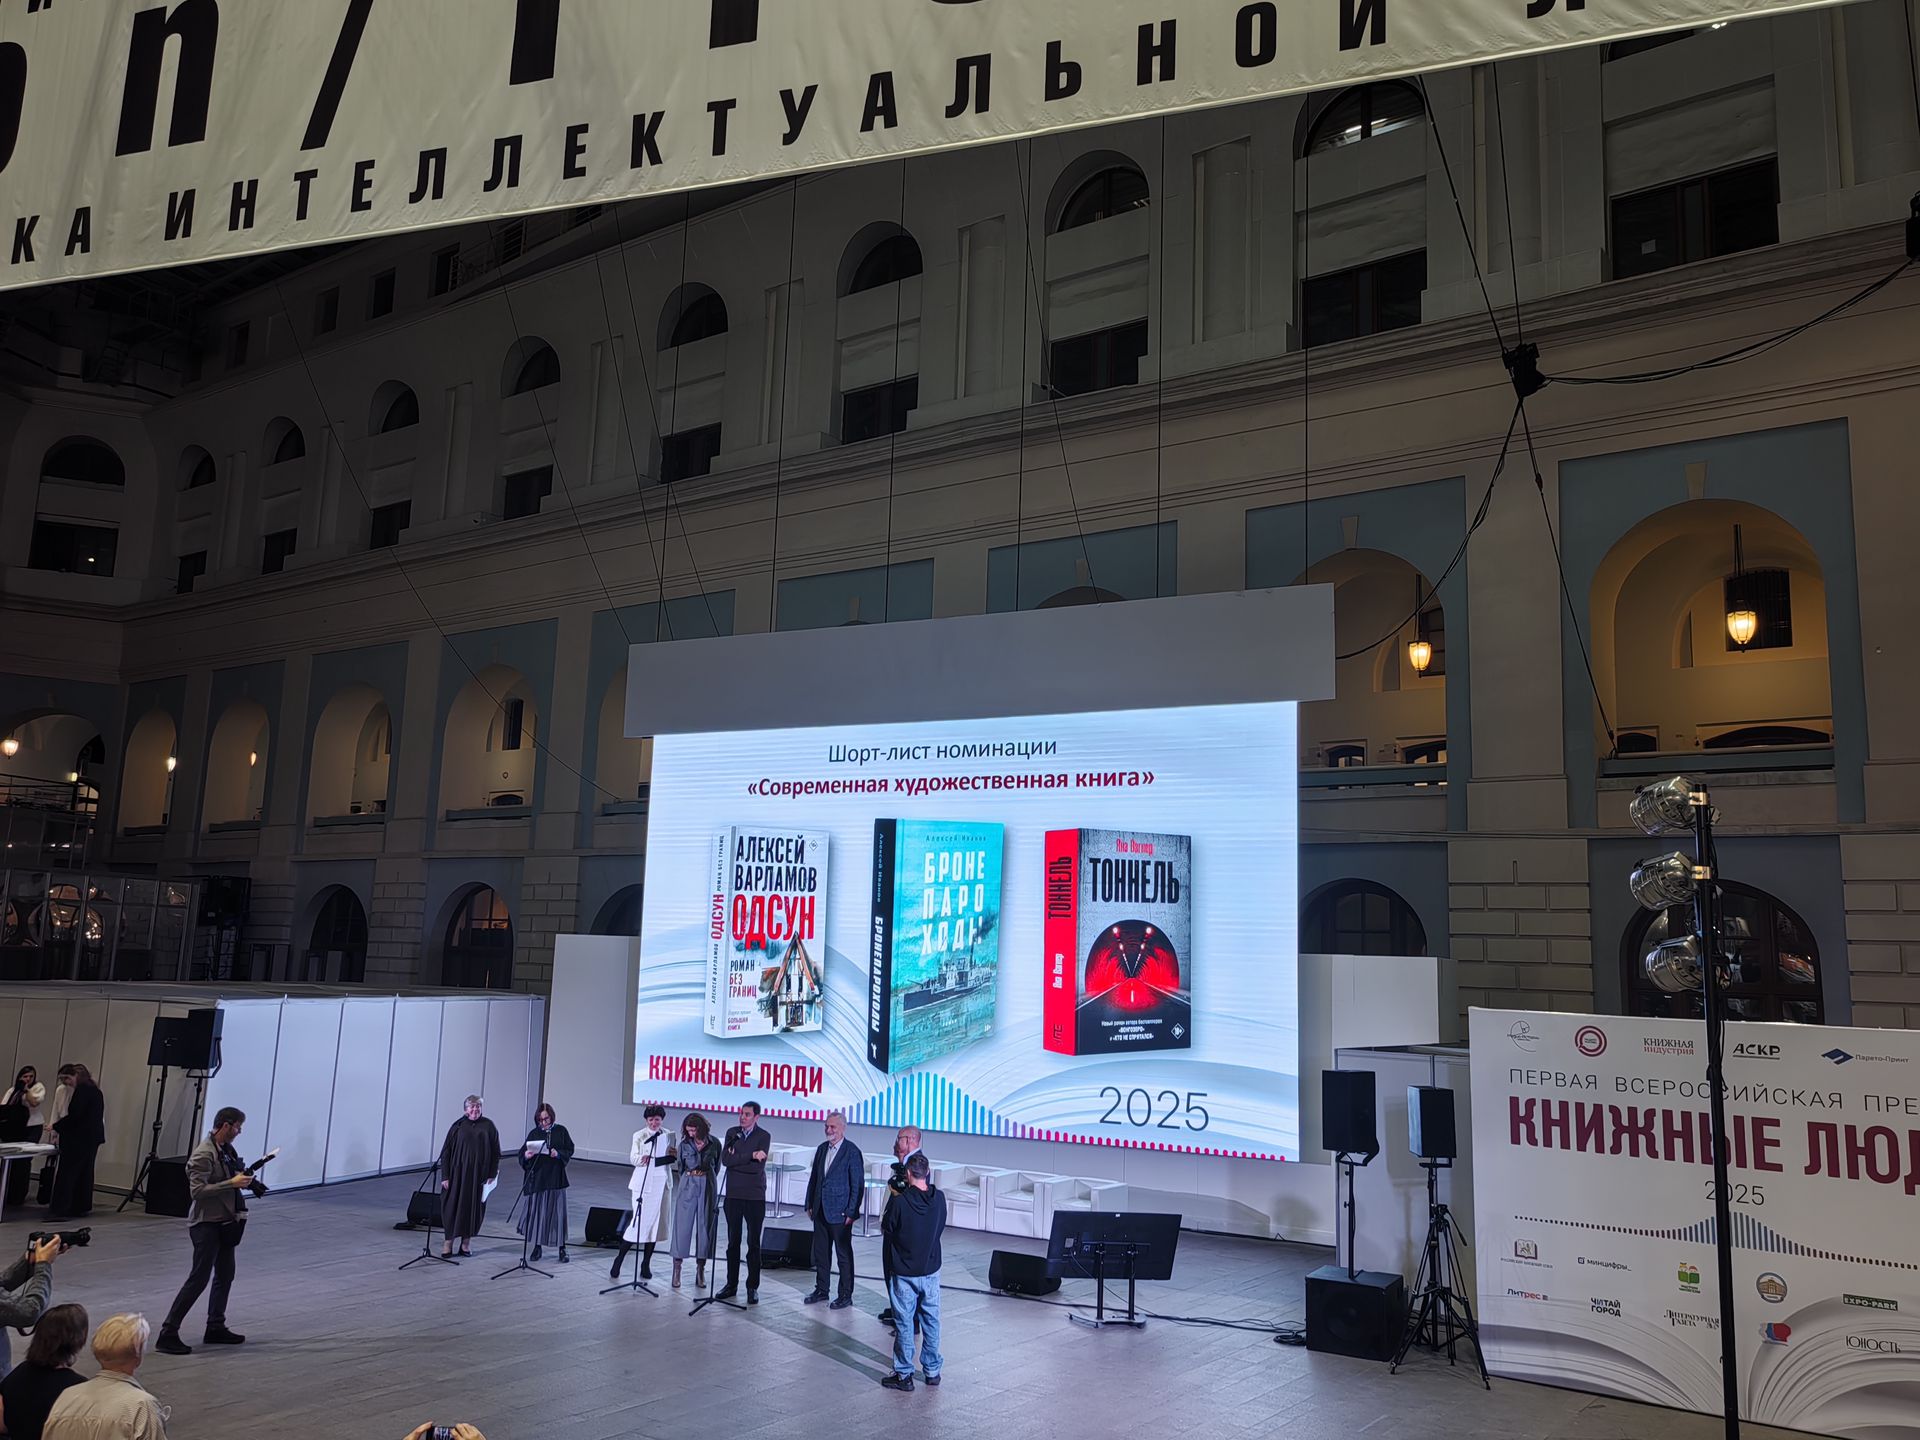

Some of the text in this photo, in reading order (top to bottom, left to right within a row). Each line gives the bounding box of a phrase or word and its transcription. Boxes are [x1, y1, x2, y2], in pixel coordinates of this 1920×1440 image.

[828, 740, 1057, 766] Шорт-лист номинации
[748, 771, 1155, 799] «Современная художественная книга»
[736, 834, 805, 864] АЛЕКСЕЙ
[734, 864, 817, 892] ВАРЛАМОВ
[924, 851, 986, 884] БРОНЕ
[1089, 858, 1180, 904] ТОННЕЛЬ
[922, 883, 985, 920] ПАРО
[1048, 856, 1072, 919] ТОННЕЛЬ
[710, 893, 725, 940] ОДСУН
[731, 893, 815, 950] ОДСУН
[729, 972, 743, 985] БЕЗ
[730, 959, 755, 972] РОМАН
[871, 916, 884, 1033] БРОНЕПАРОХОДЫ
[728, 985, 757, 999] ГРАНИЦ
[1643, 1038, 1694, 1048] КНИЖНАЯ
[1643, 1046, 1695, 1056] индустрия
[1733, 1043, 1781, 1056] АСКР
[1855, 1054, 1910, 1063] Парето-Принт
[649, 1055, 823, 1097] КНИЖНЫЕ ЛЮДИ
[1509, 1068, 1598, 1090] ПЕРВАЯ
[1615, 1076, 1843, 1109] ВСЕРОСИЙСКАЯ
[1099, 1086, 1209, 1131] 2025
[1509, 1095, 1784, 1173] КНИЖНЫЕ
[1507, 1287, 1541, 1300] Литрес
[1590, 1297, 1621, 1309] ЧИТАЙ
[1844, 1297, 1897, 1310] EXPO-PARK
[1591, 1305, 1621, 1318] ГОРОД
[1845, 1335, 1901, 1354] ЮНОСТЬ
